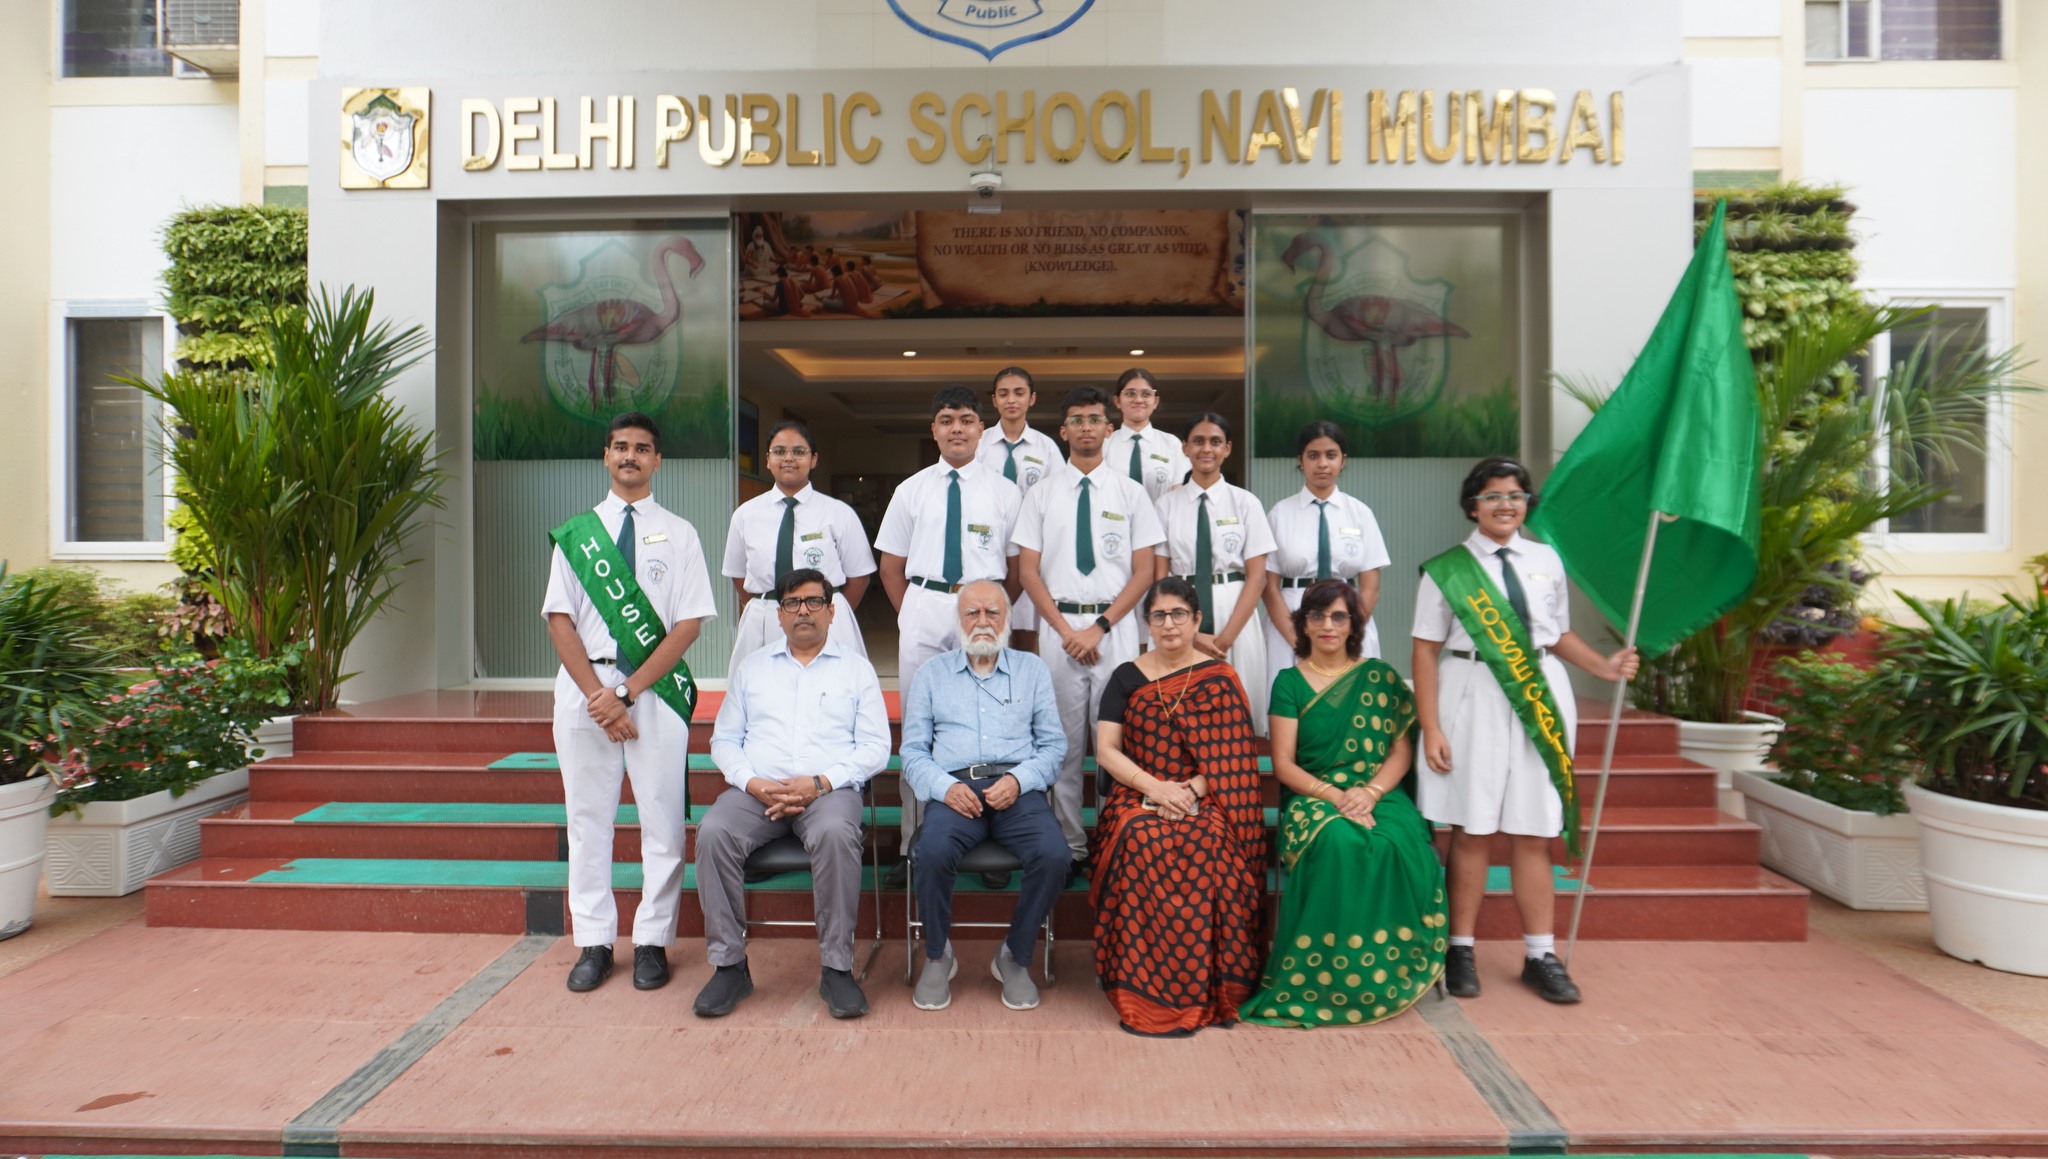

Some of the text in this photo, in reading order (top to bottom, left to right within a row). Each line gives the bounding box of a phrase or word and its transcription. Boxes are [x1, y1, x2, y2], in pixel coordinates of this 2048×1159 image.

[965, 5, 1018, 20] Public
[461, 87, 1625, 178] DELHI PUBLIC SCHOOL, NAVI MUMBAI
[952, 224, 1190, 239] THERE IS NO FRIEND, NO COMPANION,
[933, 242, 1210, 256] NO WEALTH OR NO BLISS AS GREAT AS VIDYA
[1024, 260, 1118, 275] (KNOWLEDGE).
[580, 536, 657, 648] HOUSE
[1466, 588, 1534, 683] HOUSE
